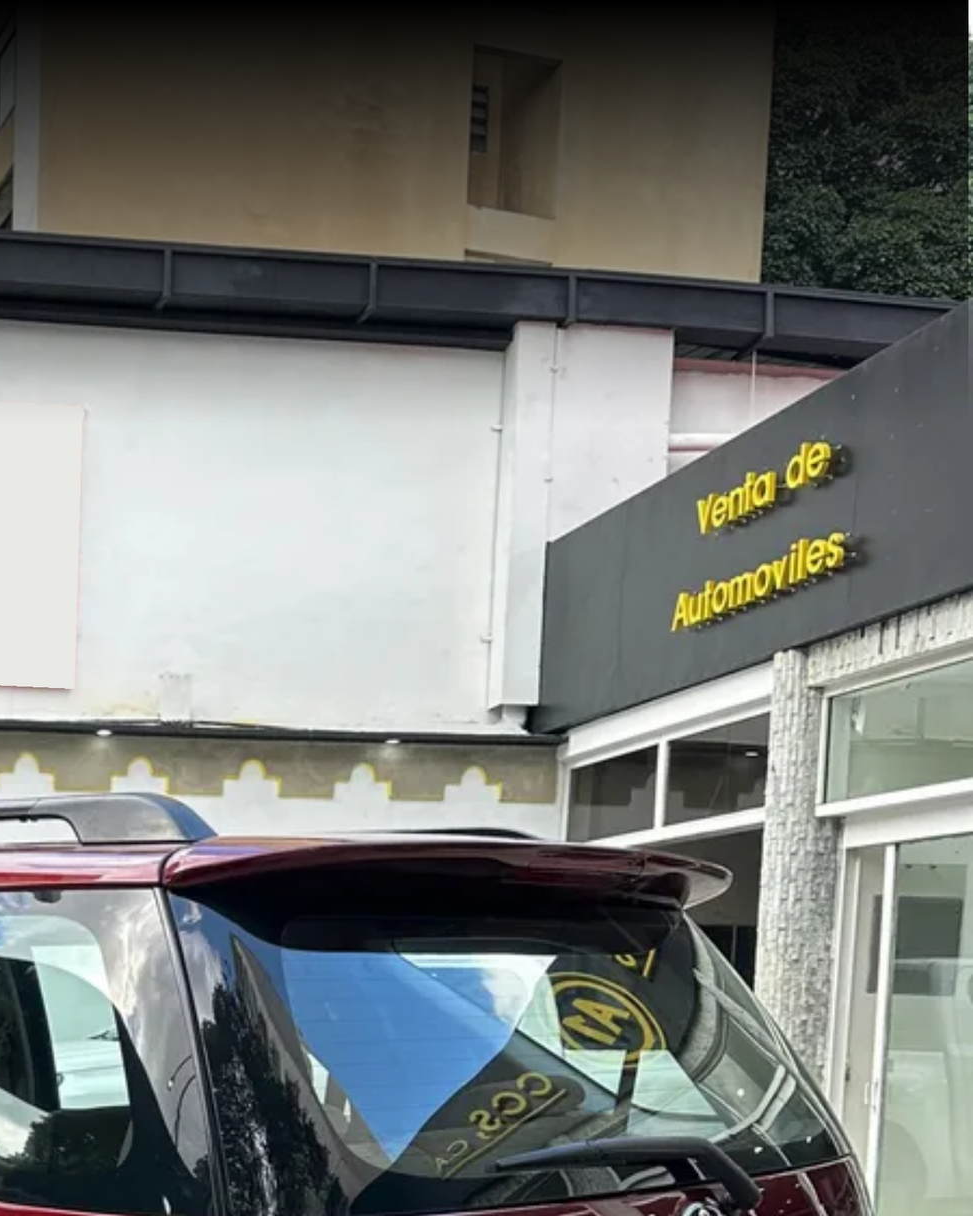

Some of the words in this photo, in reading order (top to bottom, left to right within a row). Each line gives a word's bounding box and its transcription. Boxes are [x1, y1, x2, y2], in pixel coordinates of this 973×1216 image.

[697, 470, 778, 534] Venta
[785, 440, 832, 489] de
[671, 531, 846, 631] Automoviles
